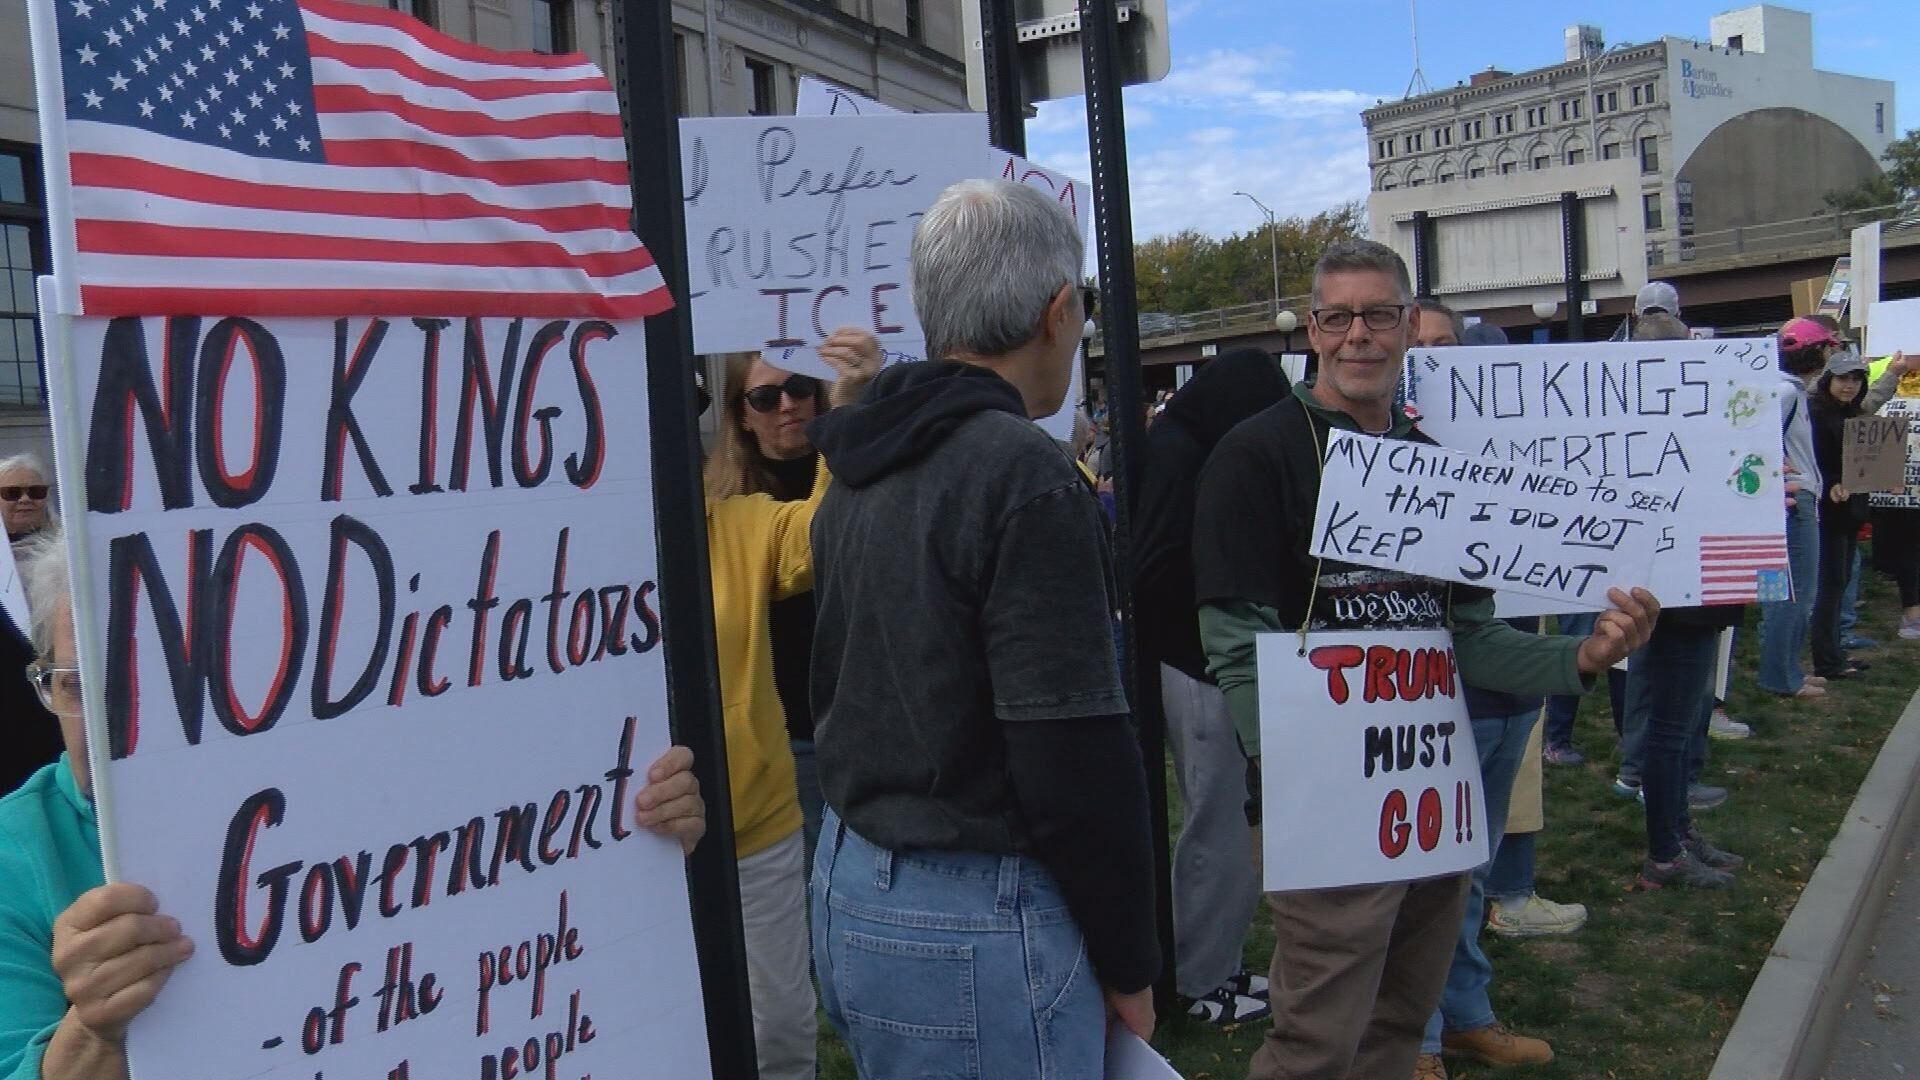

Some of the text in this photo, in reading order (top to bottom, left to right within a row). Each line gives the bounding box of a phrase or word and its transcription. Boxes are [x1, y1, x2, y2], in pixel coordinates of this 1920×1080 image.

[756, 126, 918, 238] Prefer
[758, 283, 904, 348] ICE
[86, 317, 619, 513] NO KINGS
[1324, 436, 1381, 487] MY
[1520, 472, 1578, 497] NEED
[1586, 478, 1618, 503] to
[1320, 500, 1608, 598] KEEP SILENT
[1469, 502, 1499, 522] I
[1508, 508, 1559, 529] DID
[1561, 514, 1644, 549] NOT
[105, 527, 310, 760] NO
[1364, 720, 1455, 778] MUST
[214, 716, 637, 966] Government
[373, 942, 444, 1033] the
[476, 889, 584, 1037] people
